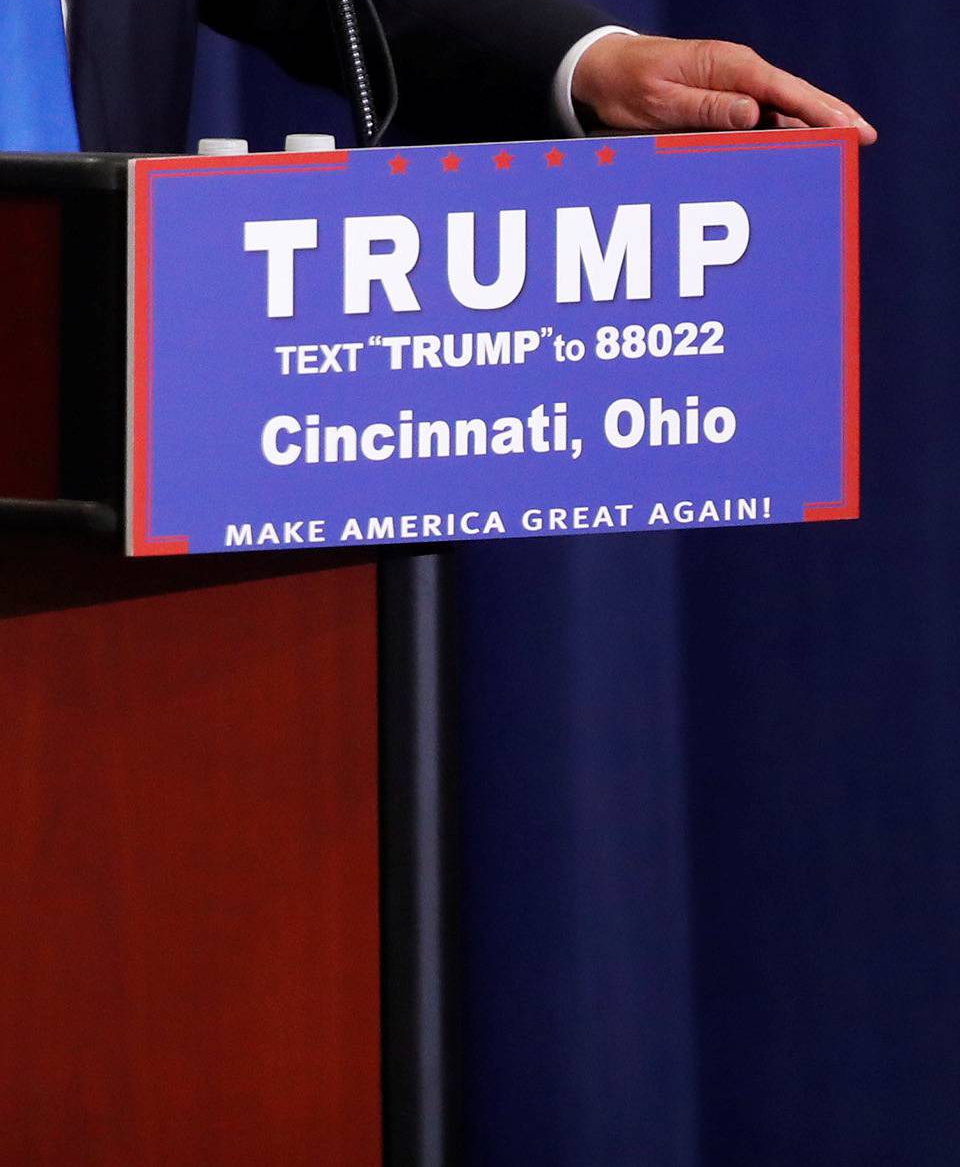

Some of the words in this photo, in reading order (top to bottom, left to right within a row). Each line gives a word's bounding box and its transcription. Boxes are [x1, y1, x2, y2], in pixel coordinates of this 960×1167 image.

[243, 200, 751, 318] TRUMP
[274, 342, 364, 376] TEXT
[553, 333, 586, 363] to
[595, 320, 725, 360] 88022
[260, 403, 583, 466] Cincinnati,
[604, 395, 737, 449] Ohio
[225, 520, 326, 547] MAKE
[340, 511, 507, 541] AMERICA
[521, 505, 634, 531] GREAT
[647, 497, 772, 526] AGAIN!
